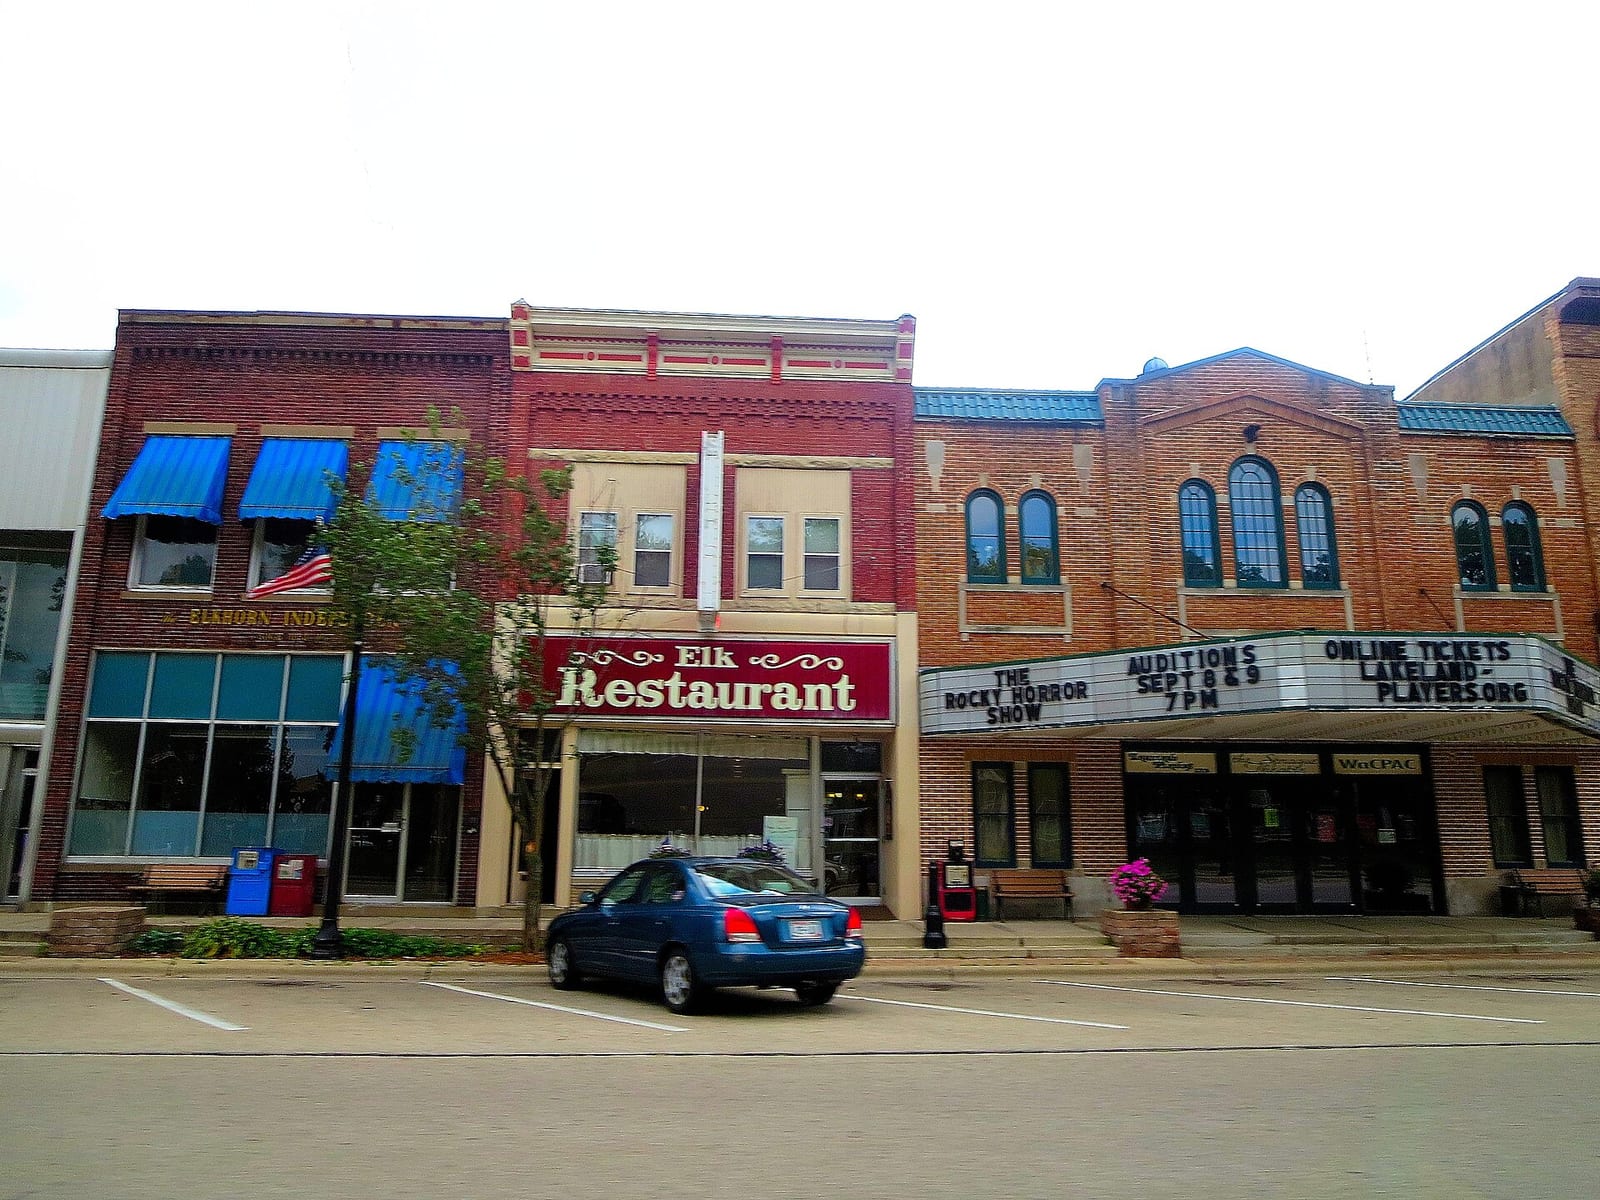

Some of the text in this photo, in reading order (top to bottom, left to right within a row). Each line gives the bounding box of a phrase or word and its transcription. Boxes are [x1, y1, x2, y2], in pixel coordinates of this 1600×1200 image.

[190, 608, 270, 625] ELKHORN
[674, 645, 739, 669] Elk
[1128, 645, 1256, 675] AUDITIONS
[1325, 640, 1511, 661] ONLINE TICKETS
[555, 666, 857, 711] Restaurant
[994, 667, 1030, 687] THE
[1138, 665, 1260, 693] SEPT 8 & 9
[945, 681, 1087, 709] ROCKY HORROR
[987, 703, 1042, 724] SHOW
